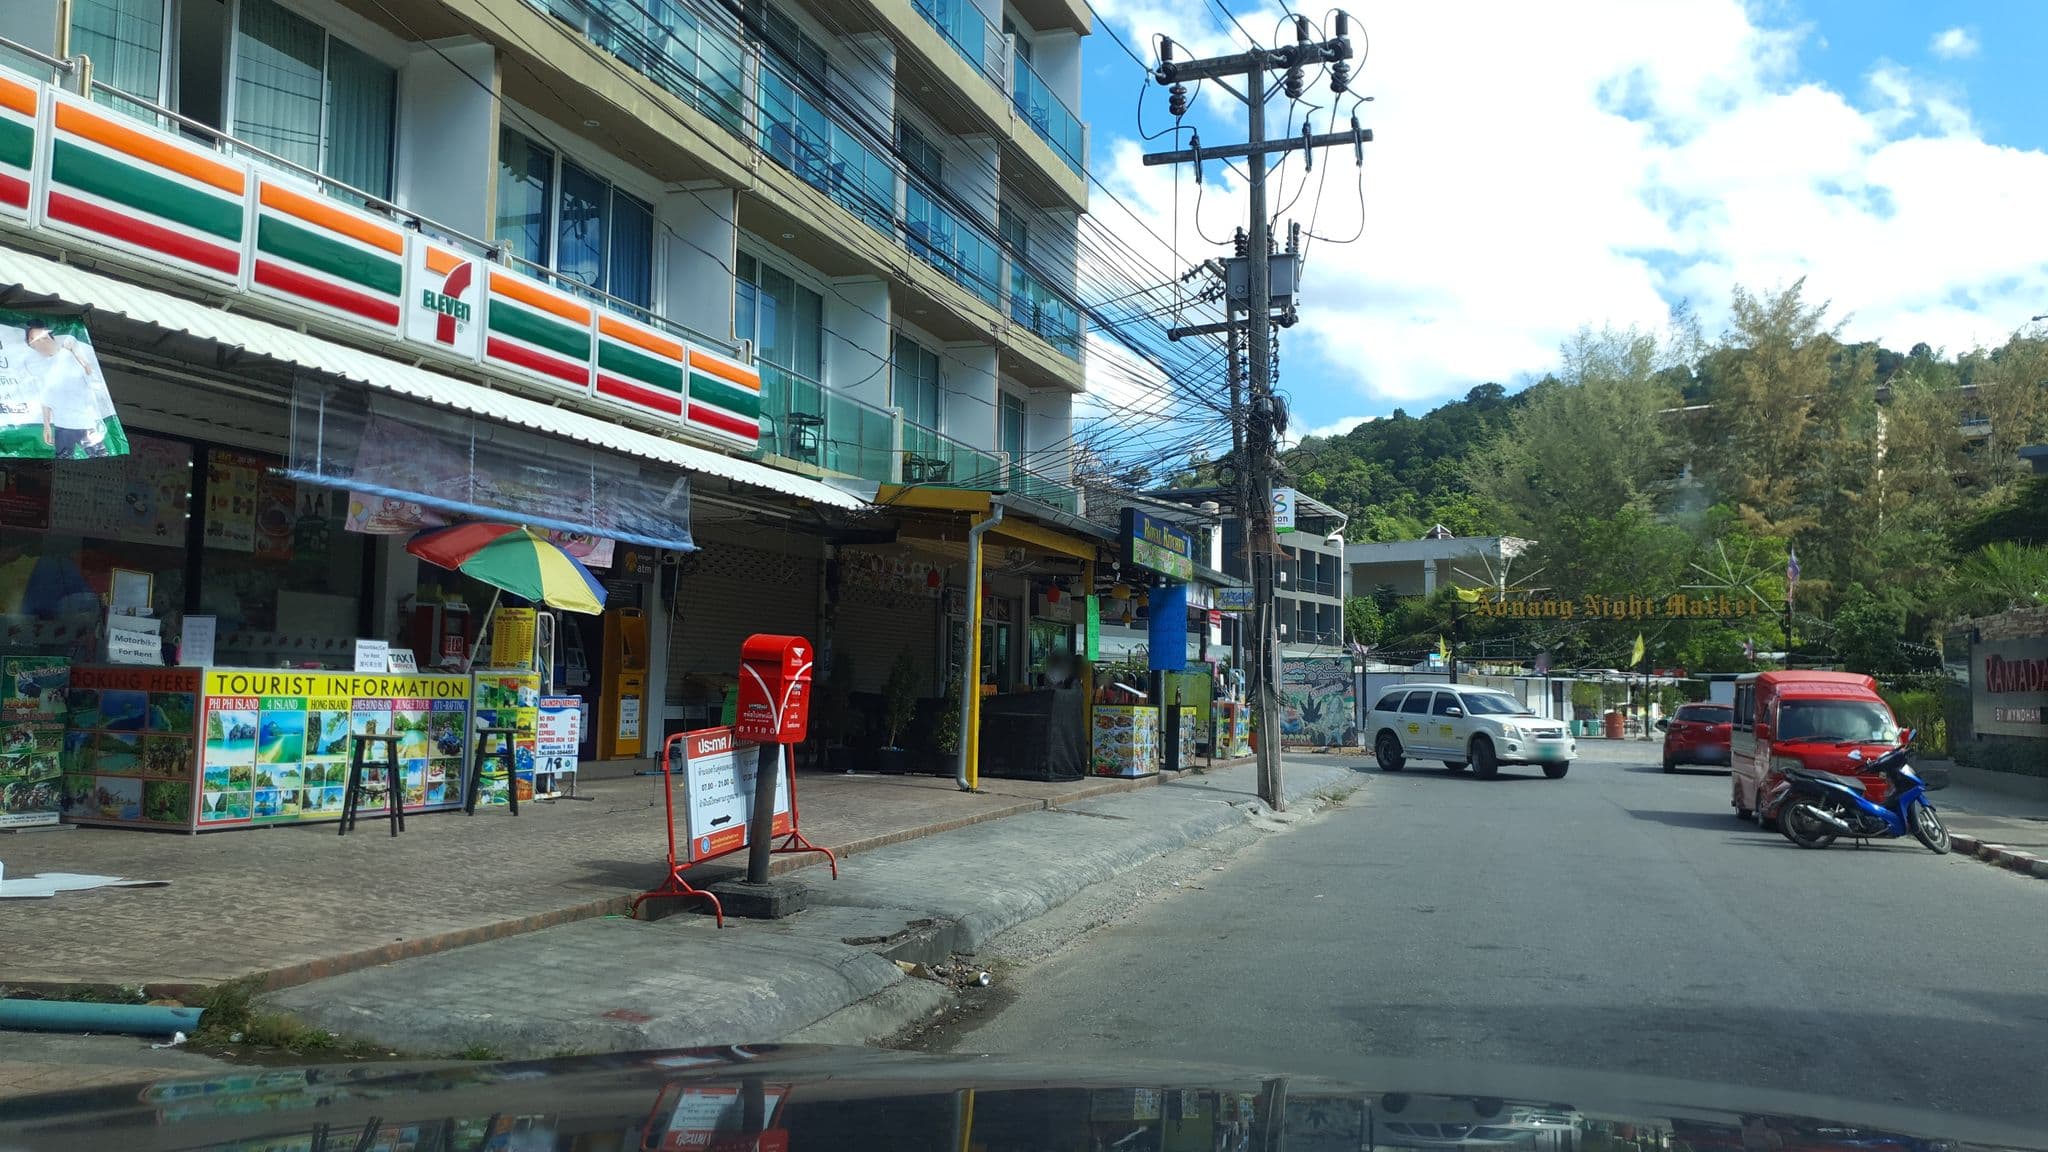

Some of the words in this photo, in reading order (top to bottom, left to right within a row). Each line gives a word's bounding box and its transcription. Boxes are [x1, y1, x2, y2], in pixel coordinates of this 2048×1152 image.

[1584, 592, 1655, 620] Night
[1665, 592, 1759, 617] Market
[115, 634, 157, 647] Motorbike
[118, 648, 133, 656] For
[134, 649, 153, 658] Rent
[389, 653, 414, 664] TAXI
[151, 673, 194, 691] HERE
[216, 674, 316, 695] TOURIST
[327, 677, 464, 697] INFORMATION
[208, 698, 221, 710] PHI
[222, 698, 234, 710] PHI
[235, 698, 259, 710] ISLAND
[266, 699, 273, 710] 4
[274, 699, 298, 710] ISLAND
[310, 699, 329, 710] HONG
[329, 699, 348, 710] ISLAND
[395, 700, 414, 710] JUNGLE
[415, 700, 430, 710] TOUR
